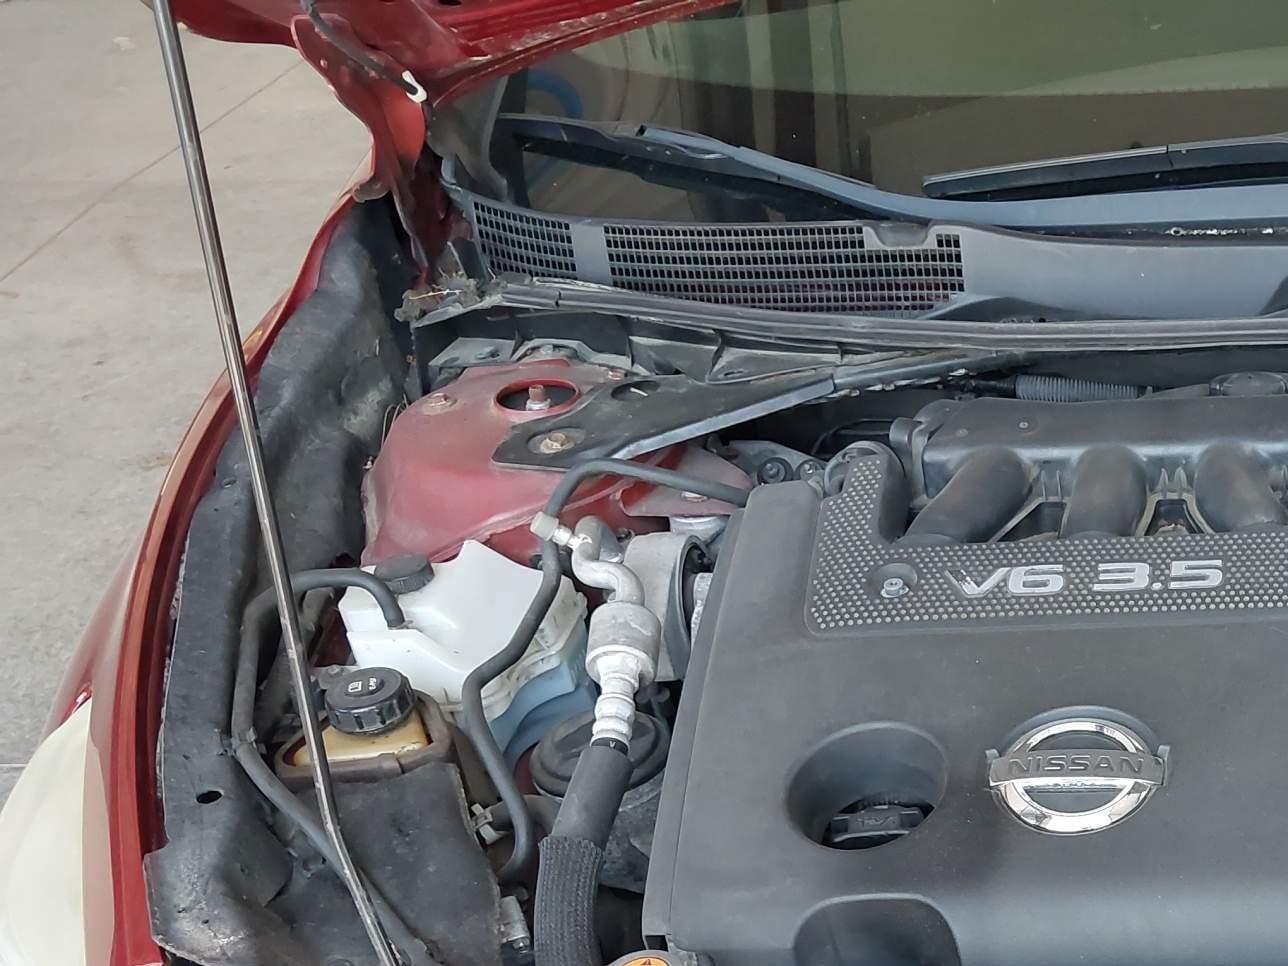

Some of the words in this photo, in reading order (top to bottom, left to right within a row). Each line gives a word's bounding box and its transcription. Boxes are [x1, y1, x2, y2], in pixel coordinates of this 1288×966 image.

[945, 564, 1065, 598] V6
[1092, 560, 1223, 591] 3.5
[1008, 754, 1145, 773] NISSAN
